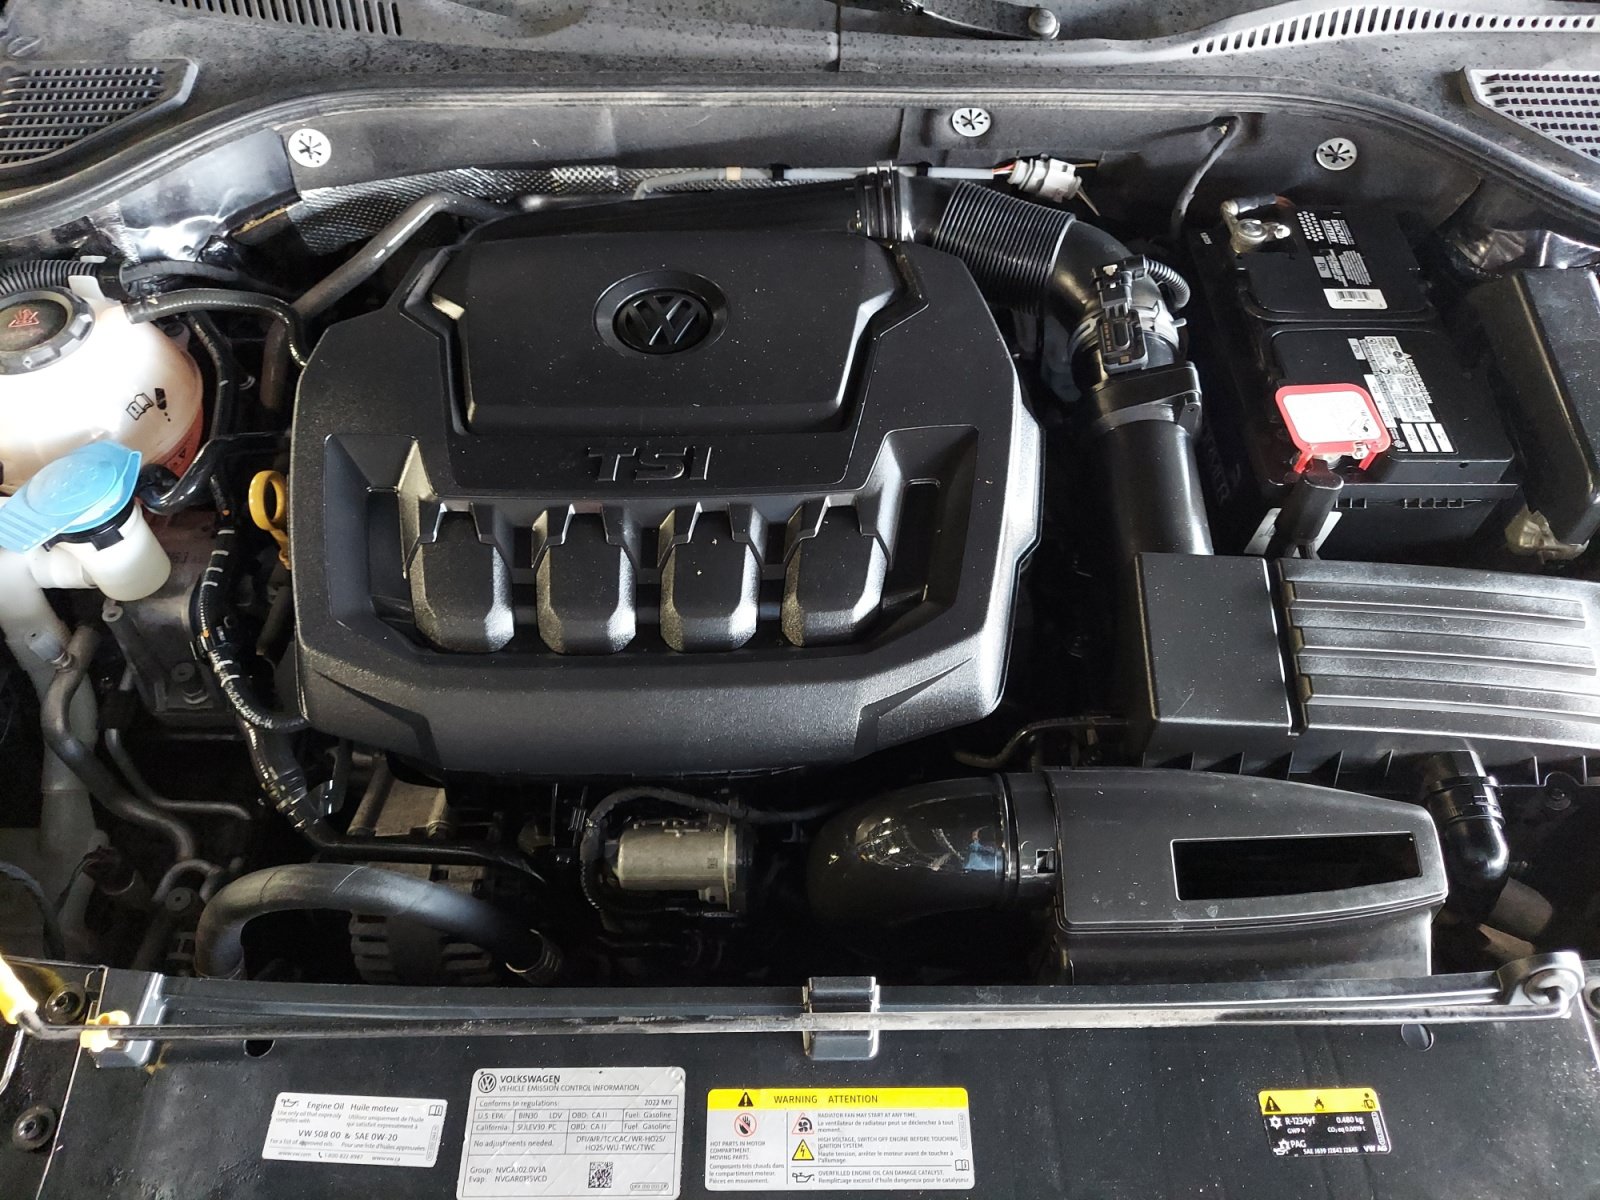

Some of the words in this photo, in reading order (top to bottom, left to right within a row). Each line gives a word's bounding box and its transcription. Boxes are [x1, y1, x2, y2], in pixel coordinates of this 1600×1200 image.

[587, 446, 712, 482] TSI
[500, 1074, 560, 1083] VOLKSWAGEN
[774, 1095, 818, 1104] WARNING
[828, 1094, 878, 1104] ATTENTION
[306, 1101, 332, 1111] Engine
[334, 1102, 344, 1110] Oil
[350, 1104, 370, 1112] Huile
[1285, 1116, 1316, 1127] R-1234yf
[1355, 1116, 1364, 1125] kg
[314, 1130, 328, 1138] 508
[484, 1140, 526, 1149] adjustments
[1290, 1140, 1306, 1148] PAG
[470, 1166, 493, 1175] Group:
